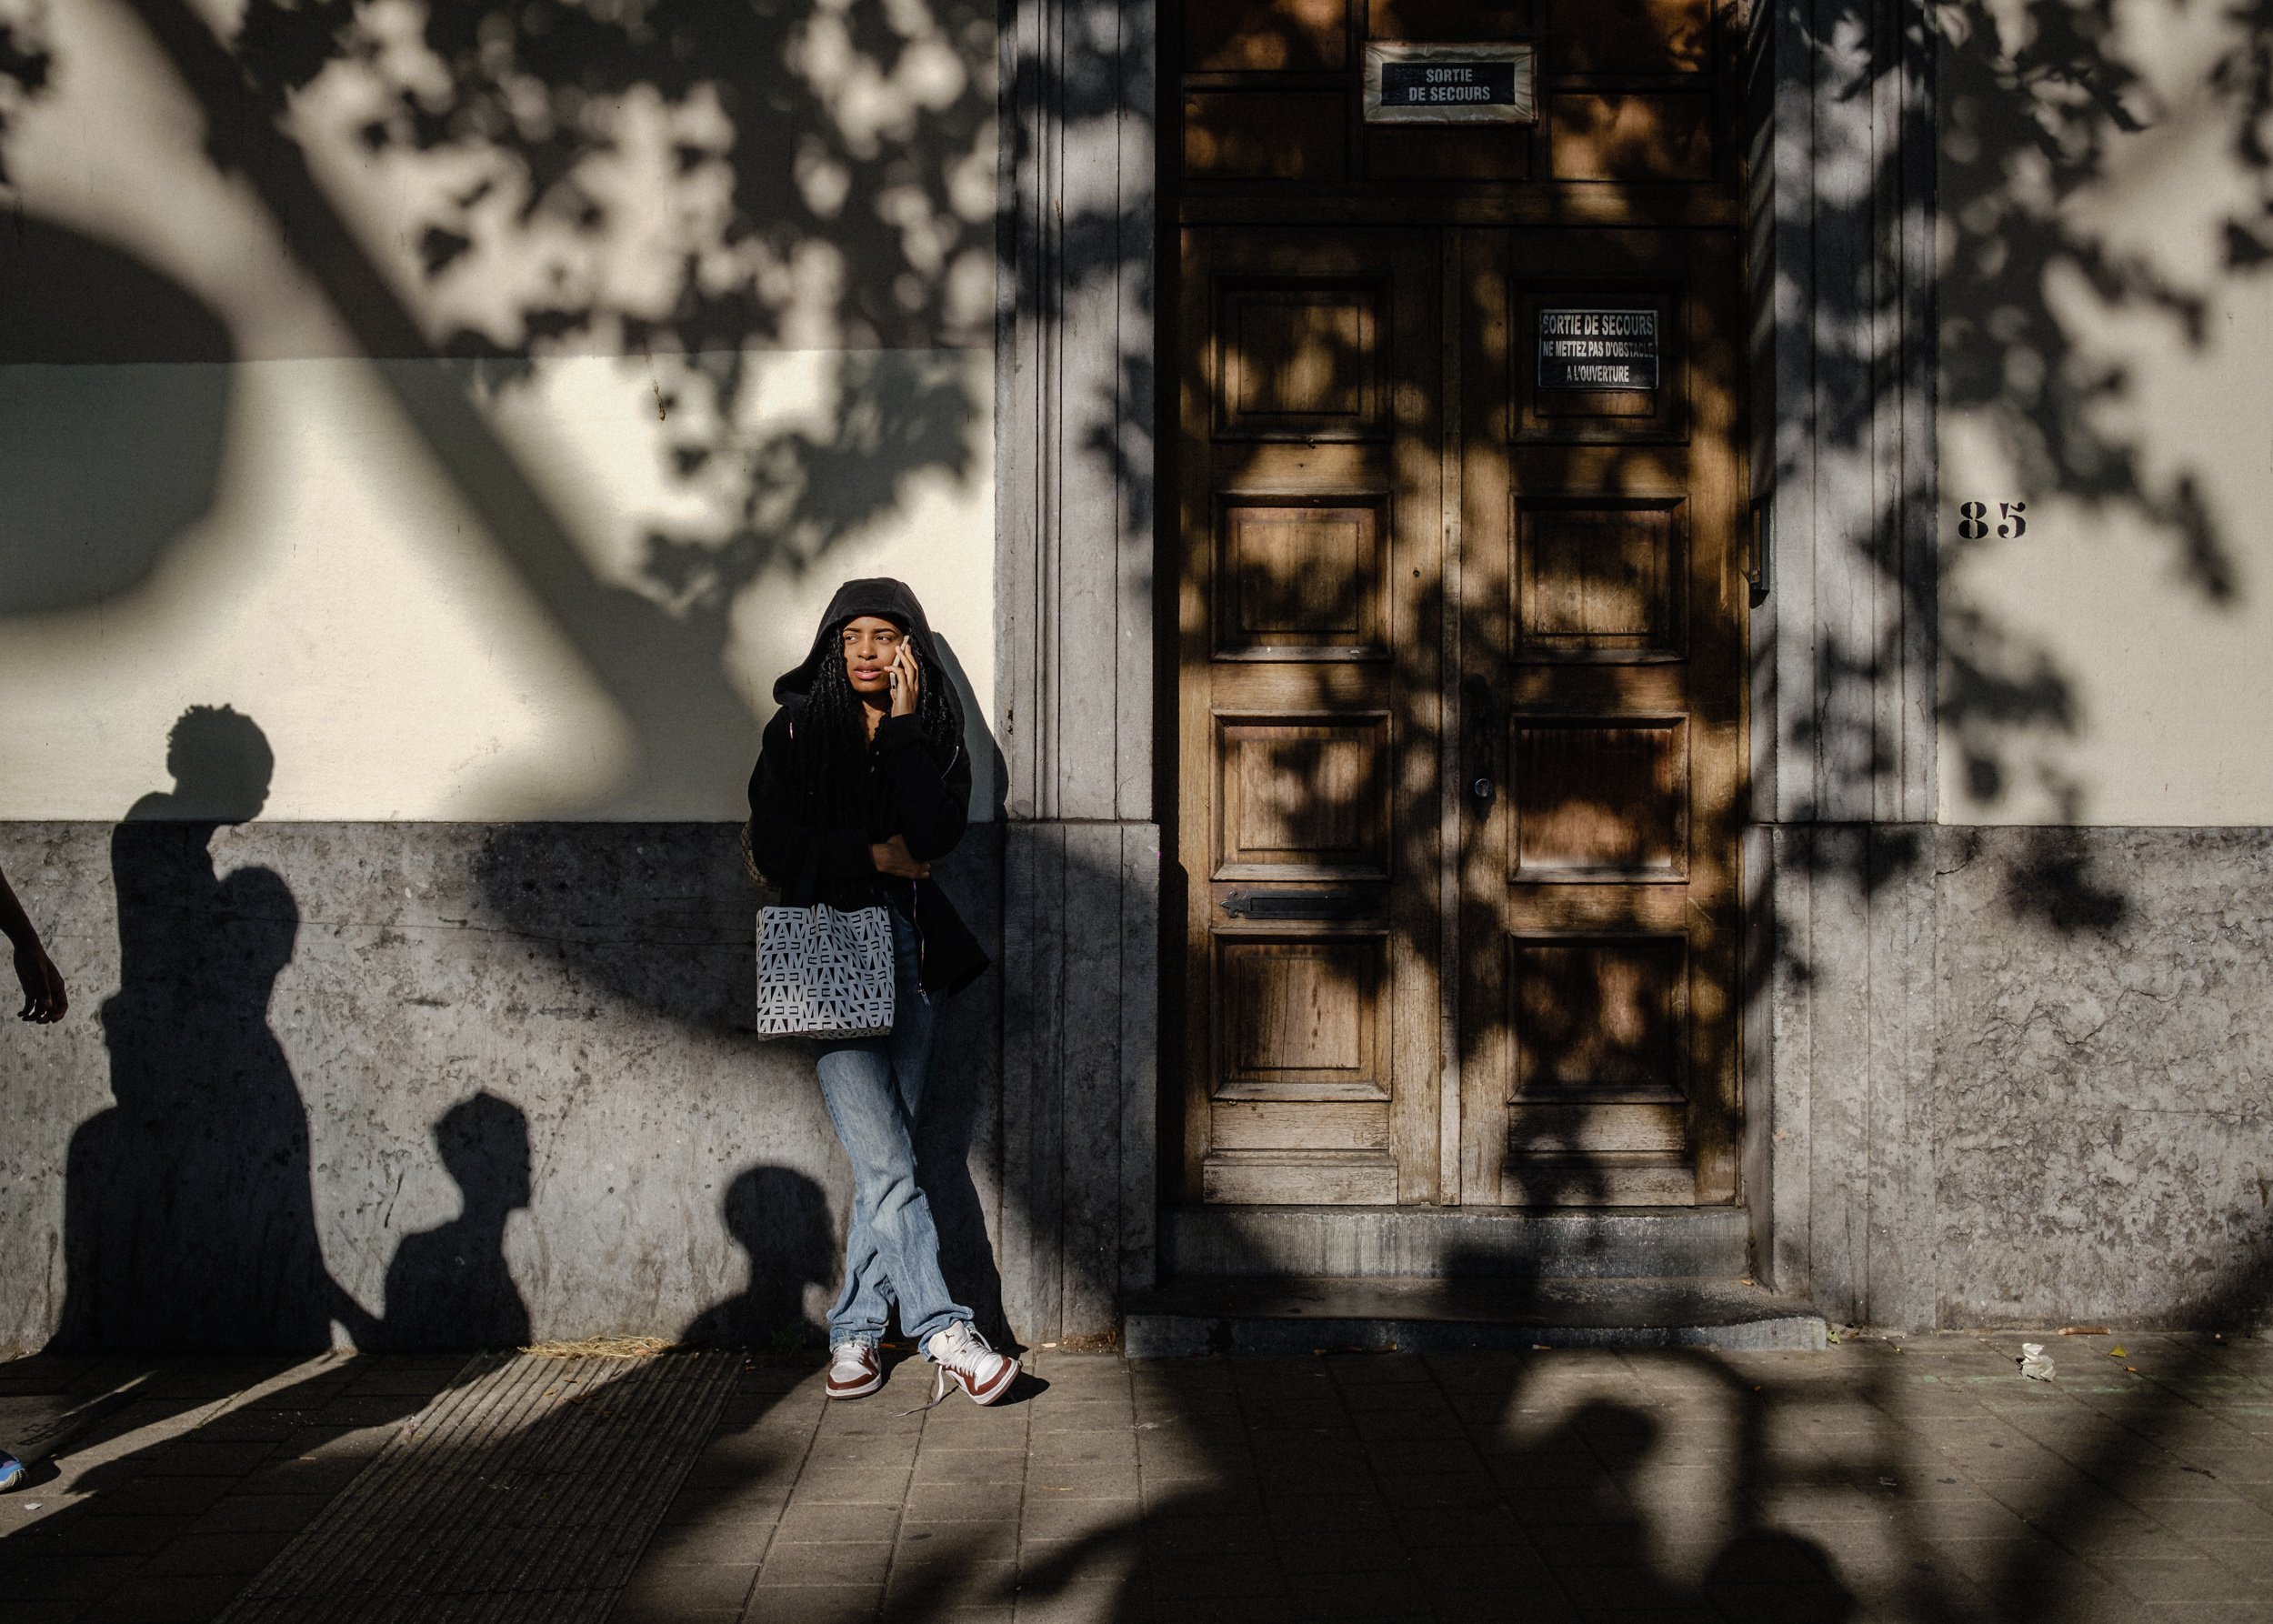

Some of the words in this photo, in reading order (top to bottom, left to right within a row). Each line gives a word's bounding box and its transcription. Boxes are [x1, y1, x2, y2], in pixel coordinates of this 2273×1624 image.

[1426, 68, 1473, 83] SORTIE
[1409, 86, 1426, 101] DE
[1429, 85, 1491, 101] SECOURS
[1543, 315, 1581, 336] SORTIE
[1584, 315, 1599, 336] DE
[1601, 315, 1654, 336] SECOURS
[1543, 340, 1554, 357] NE
[1555, 340, 1587, 357] METTEZ
[1588, 340, 1604, 357] PAS
[1605, 341, 1654, 358] D'OBSTACLE
[1574, 365, 1629, 382] L'OUVERTURE
[1958, 501, 2027, 539] 85
[759, 967, 846, 985] ZEEMAN
[757, 1001, 848, 1018] ZEEMAN
